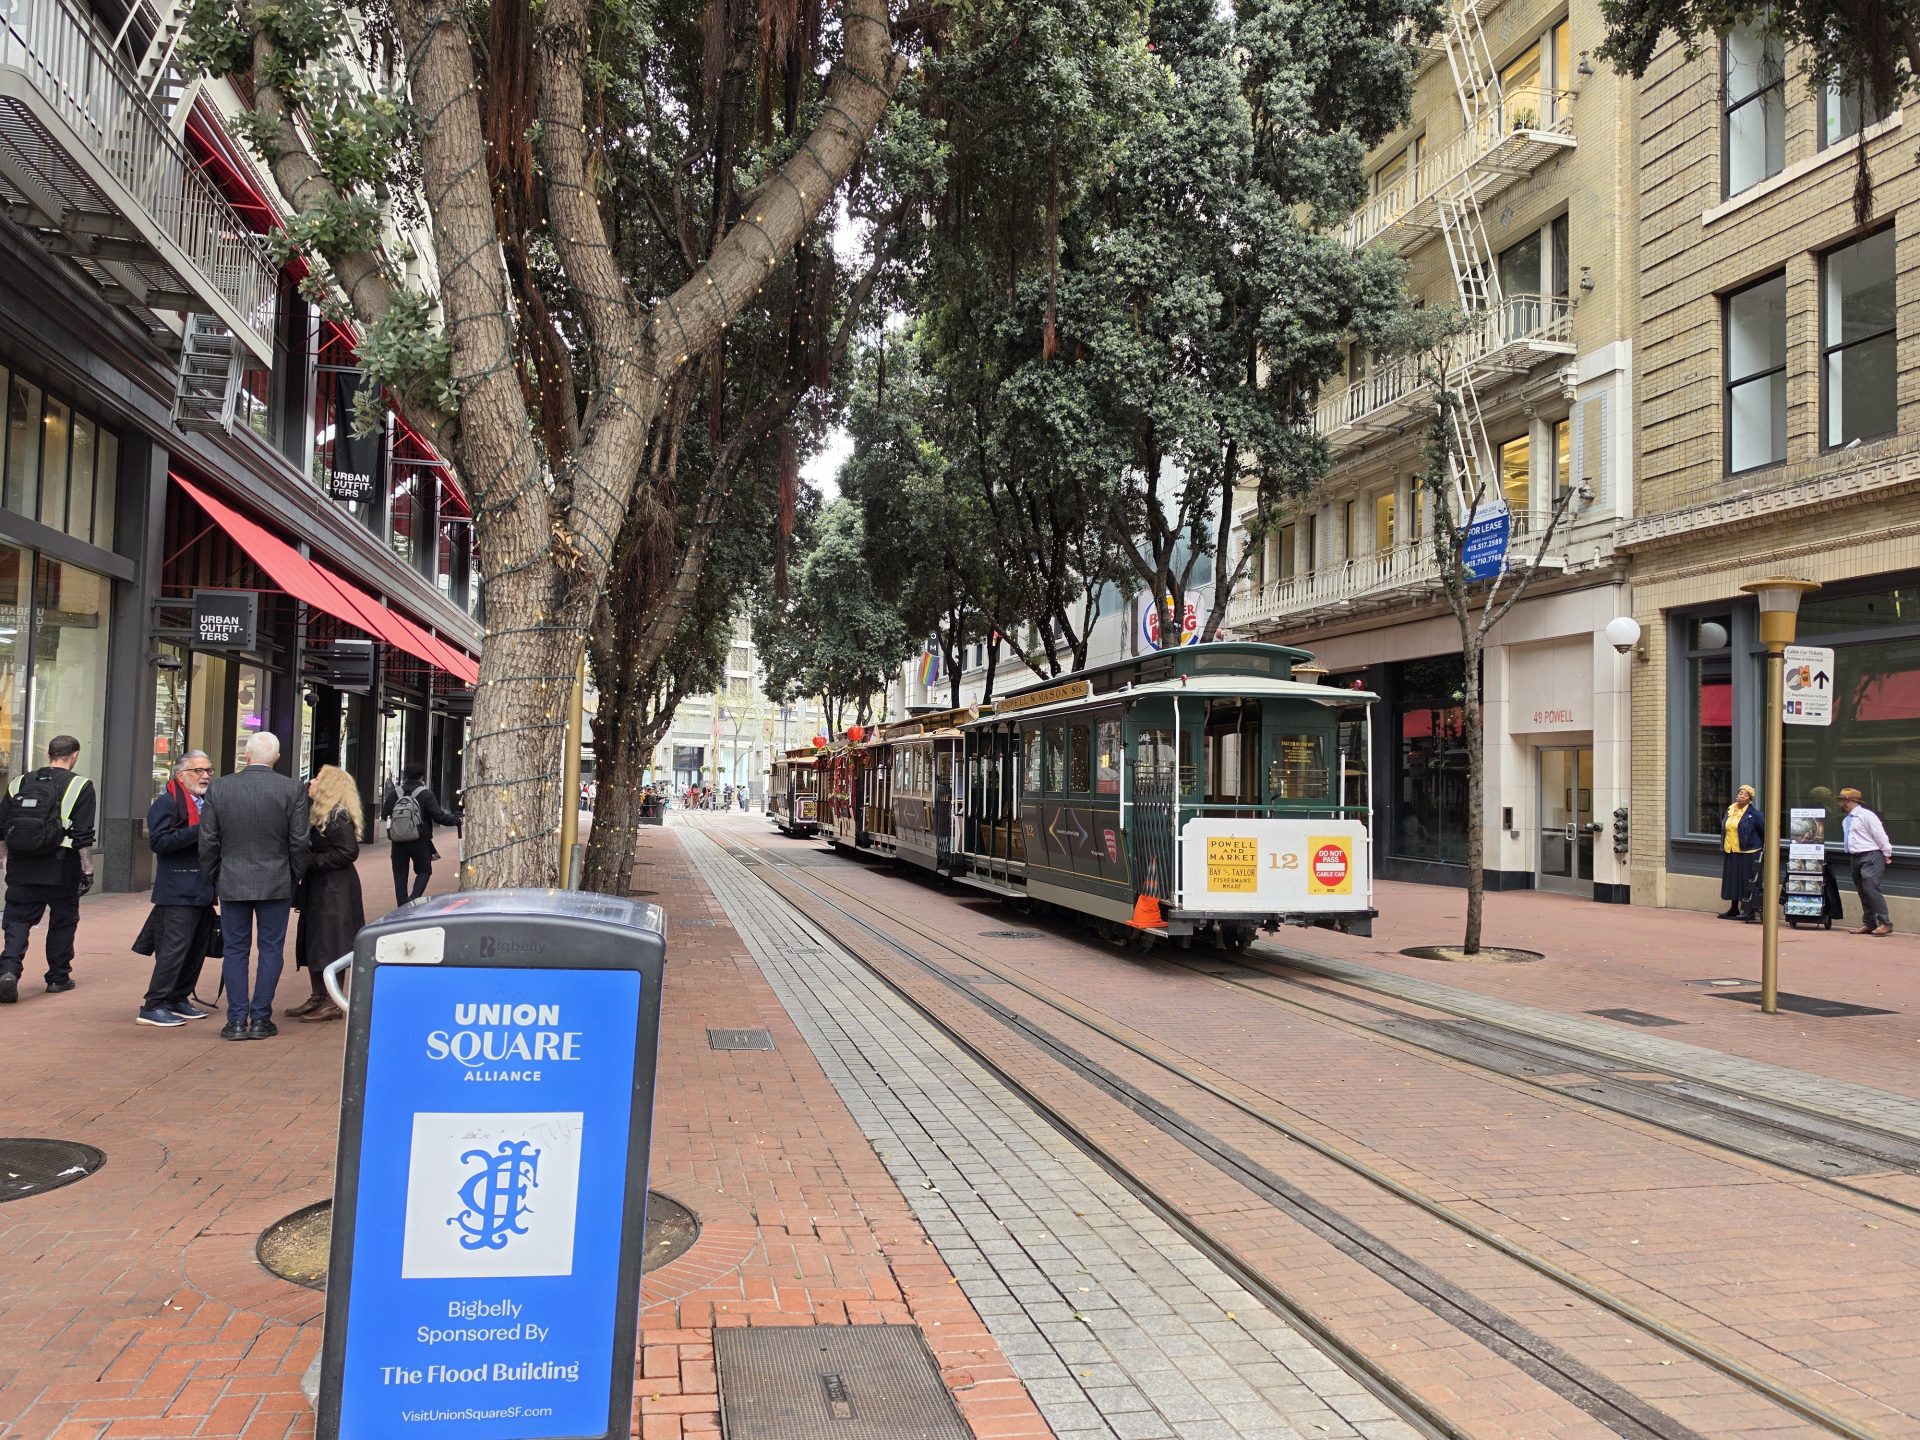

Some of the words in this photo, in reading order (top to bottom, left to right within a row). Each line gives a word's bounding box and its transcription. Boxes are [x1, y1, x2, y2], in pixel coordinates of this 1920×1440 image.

[333, 471, 370, 482] URBAN
[333, 480, 372, 490] OUTFIT-
[333, 488, 359, 498] TERS
[1481, 520, 1503, 533] LEASE
[1467, 538, 1503, 552] 415.517.2589
[200, 614, 239, 624] URBAN
[199, 624, 244, 634] OUTFIT-
[200, 632, 229, 642] TERS
[1001, 698, 1029, 710] POWELL
[1038, 688, 1068, 701] MASON
[1533, 711, 1543, 723] 49
[1544, 709, 1574, 723] POWELL
[1024, 824, 1035, 837] 12
[1211, 840, 1256, 849] POWELL
[1268, 852, 1299, 869] 12
[1209, 868, 1221, 876] BAY
[1232, 868, 1256, 877] TAYLOR
[454, 1003, 560, 1027] UNION
[426, 1030, 584, 1068] SQUARE
[463, 1070, 542, 1083] ALLIANCE
[448, 1299, 523, 1321] Bigbelly
[416, 1324, 522, 1345] Sponsored
[525, 1324, 549, 1342] By
[380, 1365, 423, 1386] The
[427, 1361, 488, 1384] Flood
[492, 1360, 580, 1383] Building
[401, 1405, 553, 1423] VisitUnionSquareSF.com
